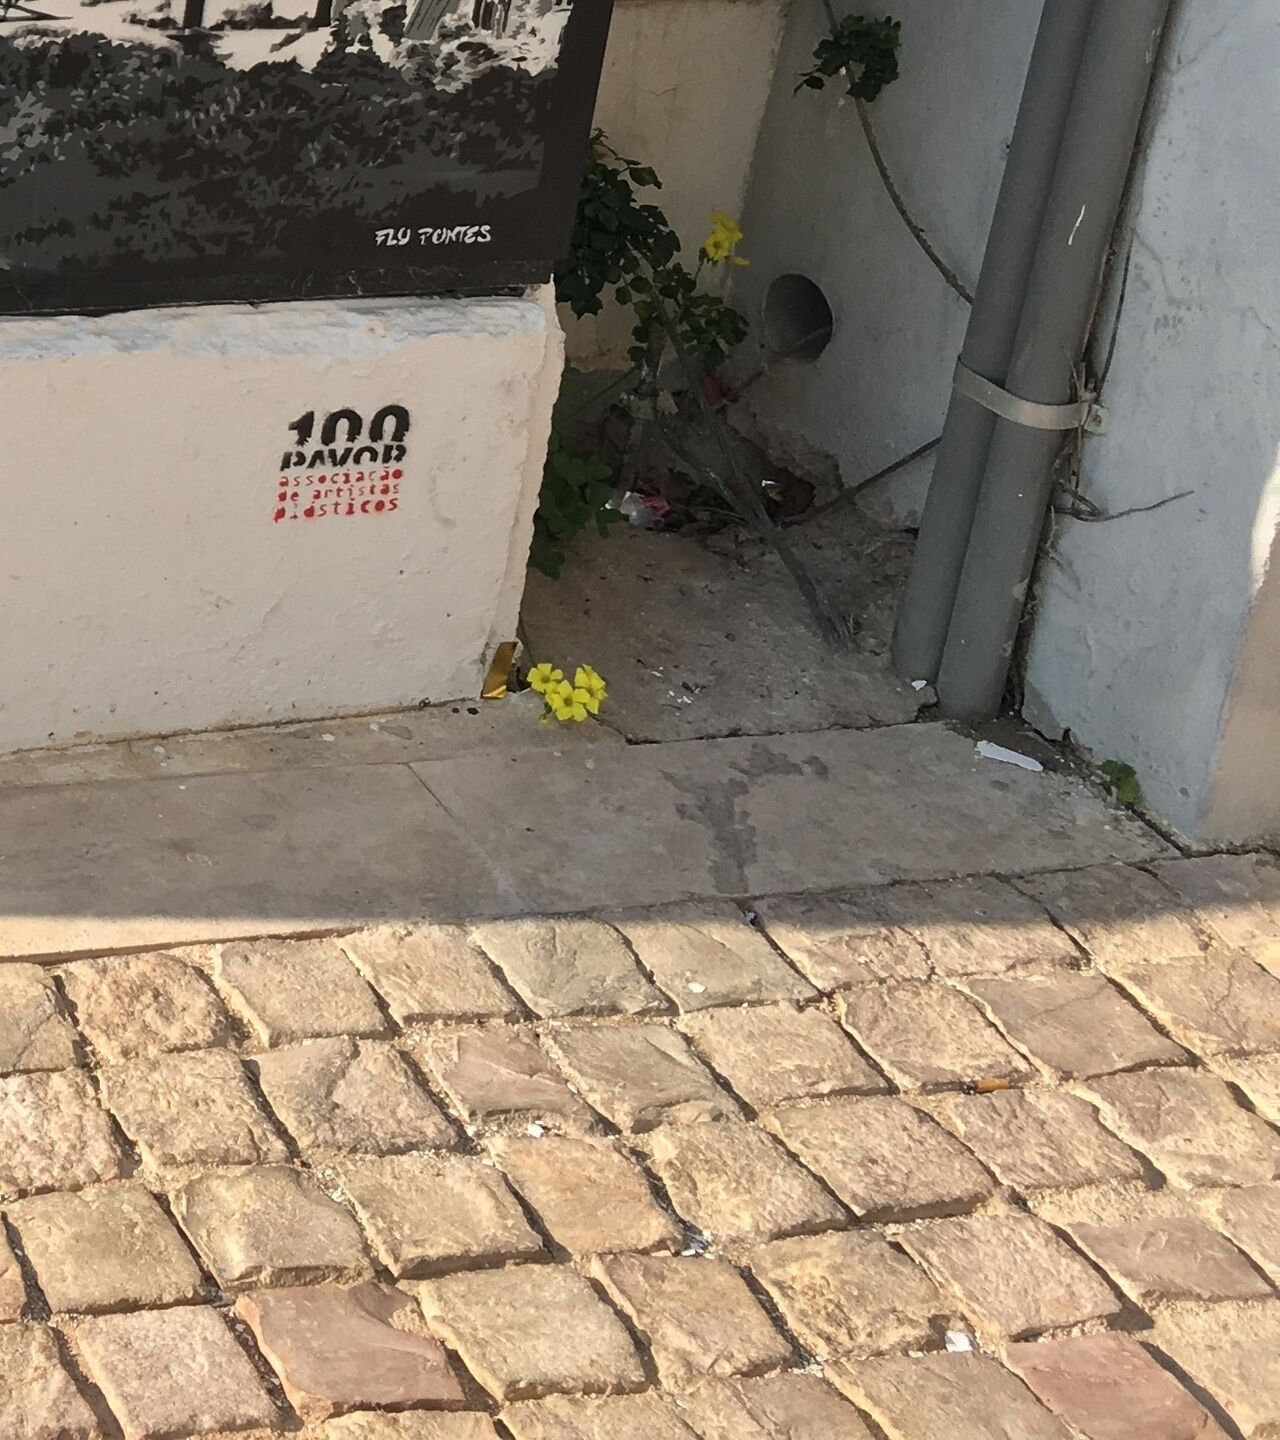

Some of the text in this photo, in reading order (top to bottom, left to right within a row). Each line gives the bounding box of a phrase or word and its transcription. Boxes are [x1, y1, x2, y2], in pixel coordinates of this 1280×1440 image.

[417, 224, 492, 245] PONTES
[288, 404, 411, 446] 100
[278, 466, 404, 487] associação
[278, 484, 400, 502] de artistas
